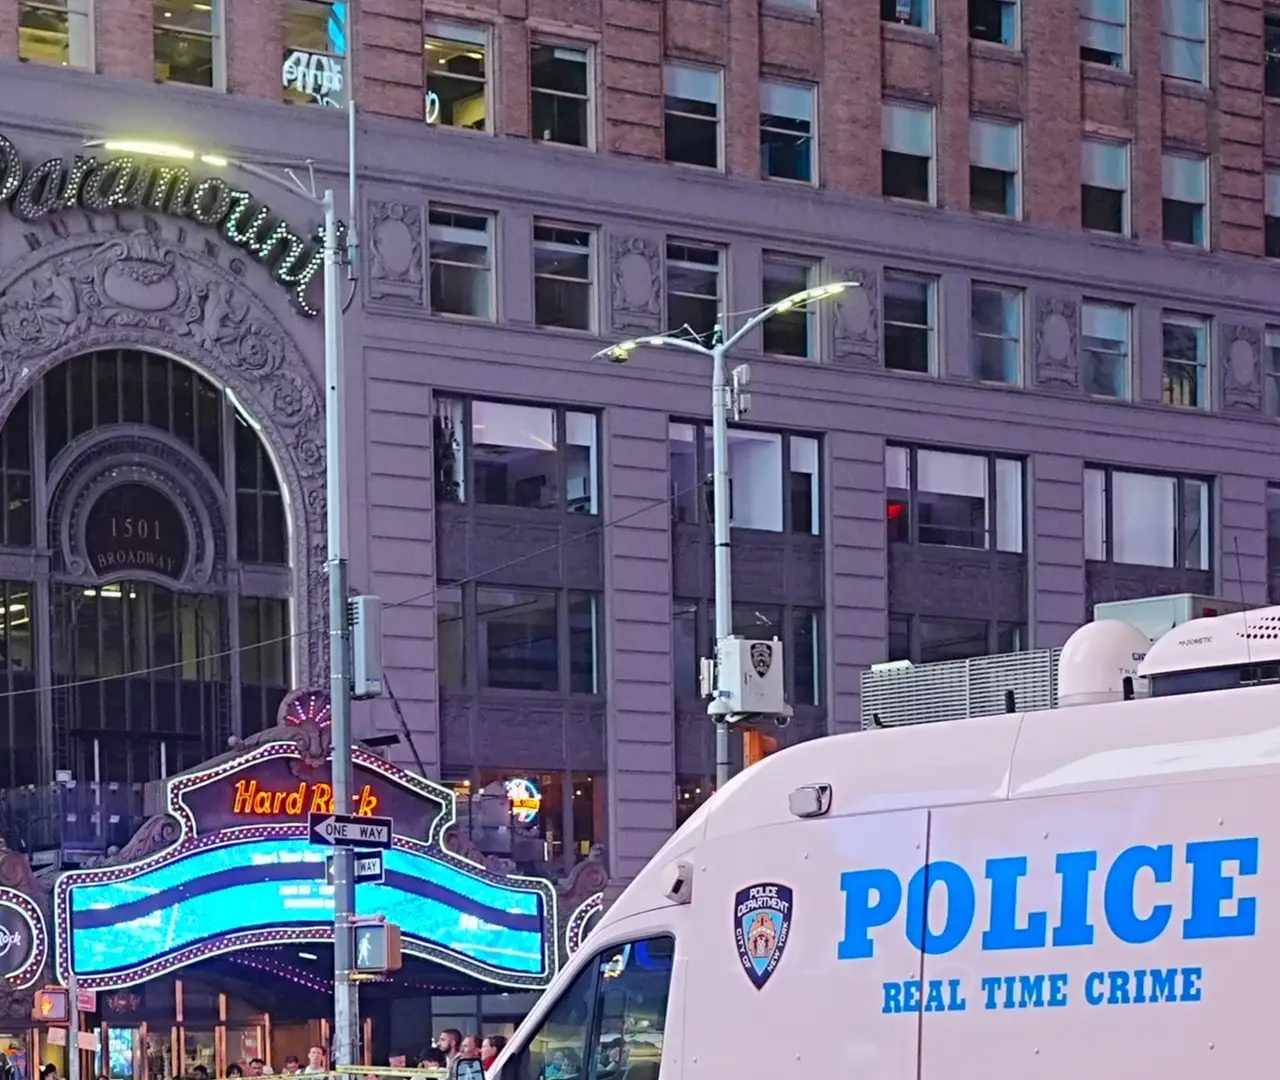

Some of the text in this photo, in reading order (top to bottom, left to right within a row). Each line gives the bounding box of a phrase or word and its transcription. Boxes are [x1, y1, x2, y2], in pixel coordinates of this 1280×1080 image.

[111, 517, 160, 540] 1501
[98, 549, 175, 571] BROADWAY
[233, 779, 377, 816] Hard Rk
[326, 824, 384, 839] ONE WAY
[358, 861, 377, 874] WAY
[750, 886, 778, 899] POLICE
[837, 837, 1259, 960] POLICE
[737, 897, 789, 917] DEPARTMENT
[736, 928, 752, 968] CITY OF
[767, 921, 789, 973] NEW YORK
[881, 967, 1202, 1014] REAL TIME CRIME
